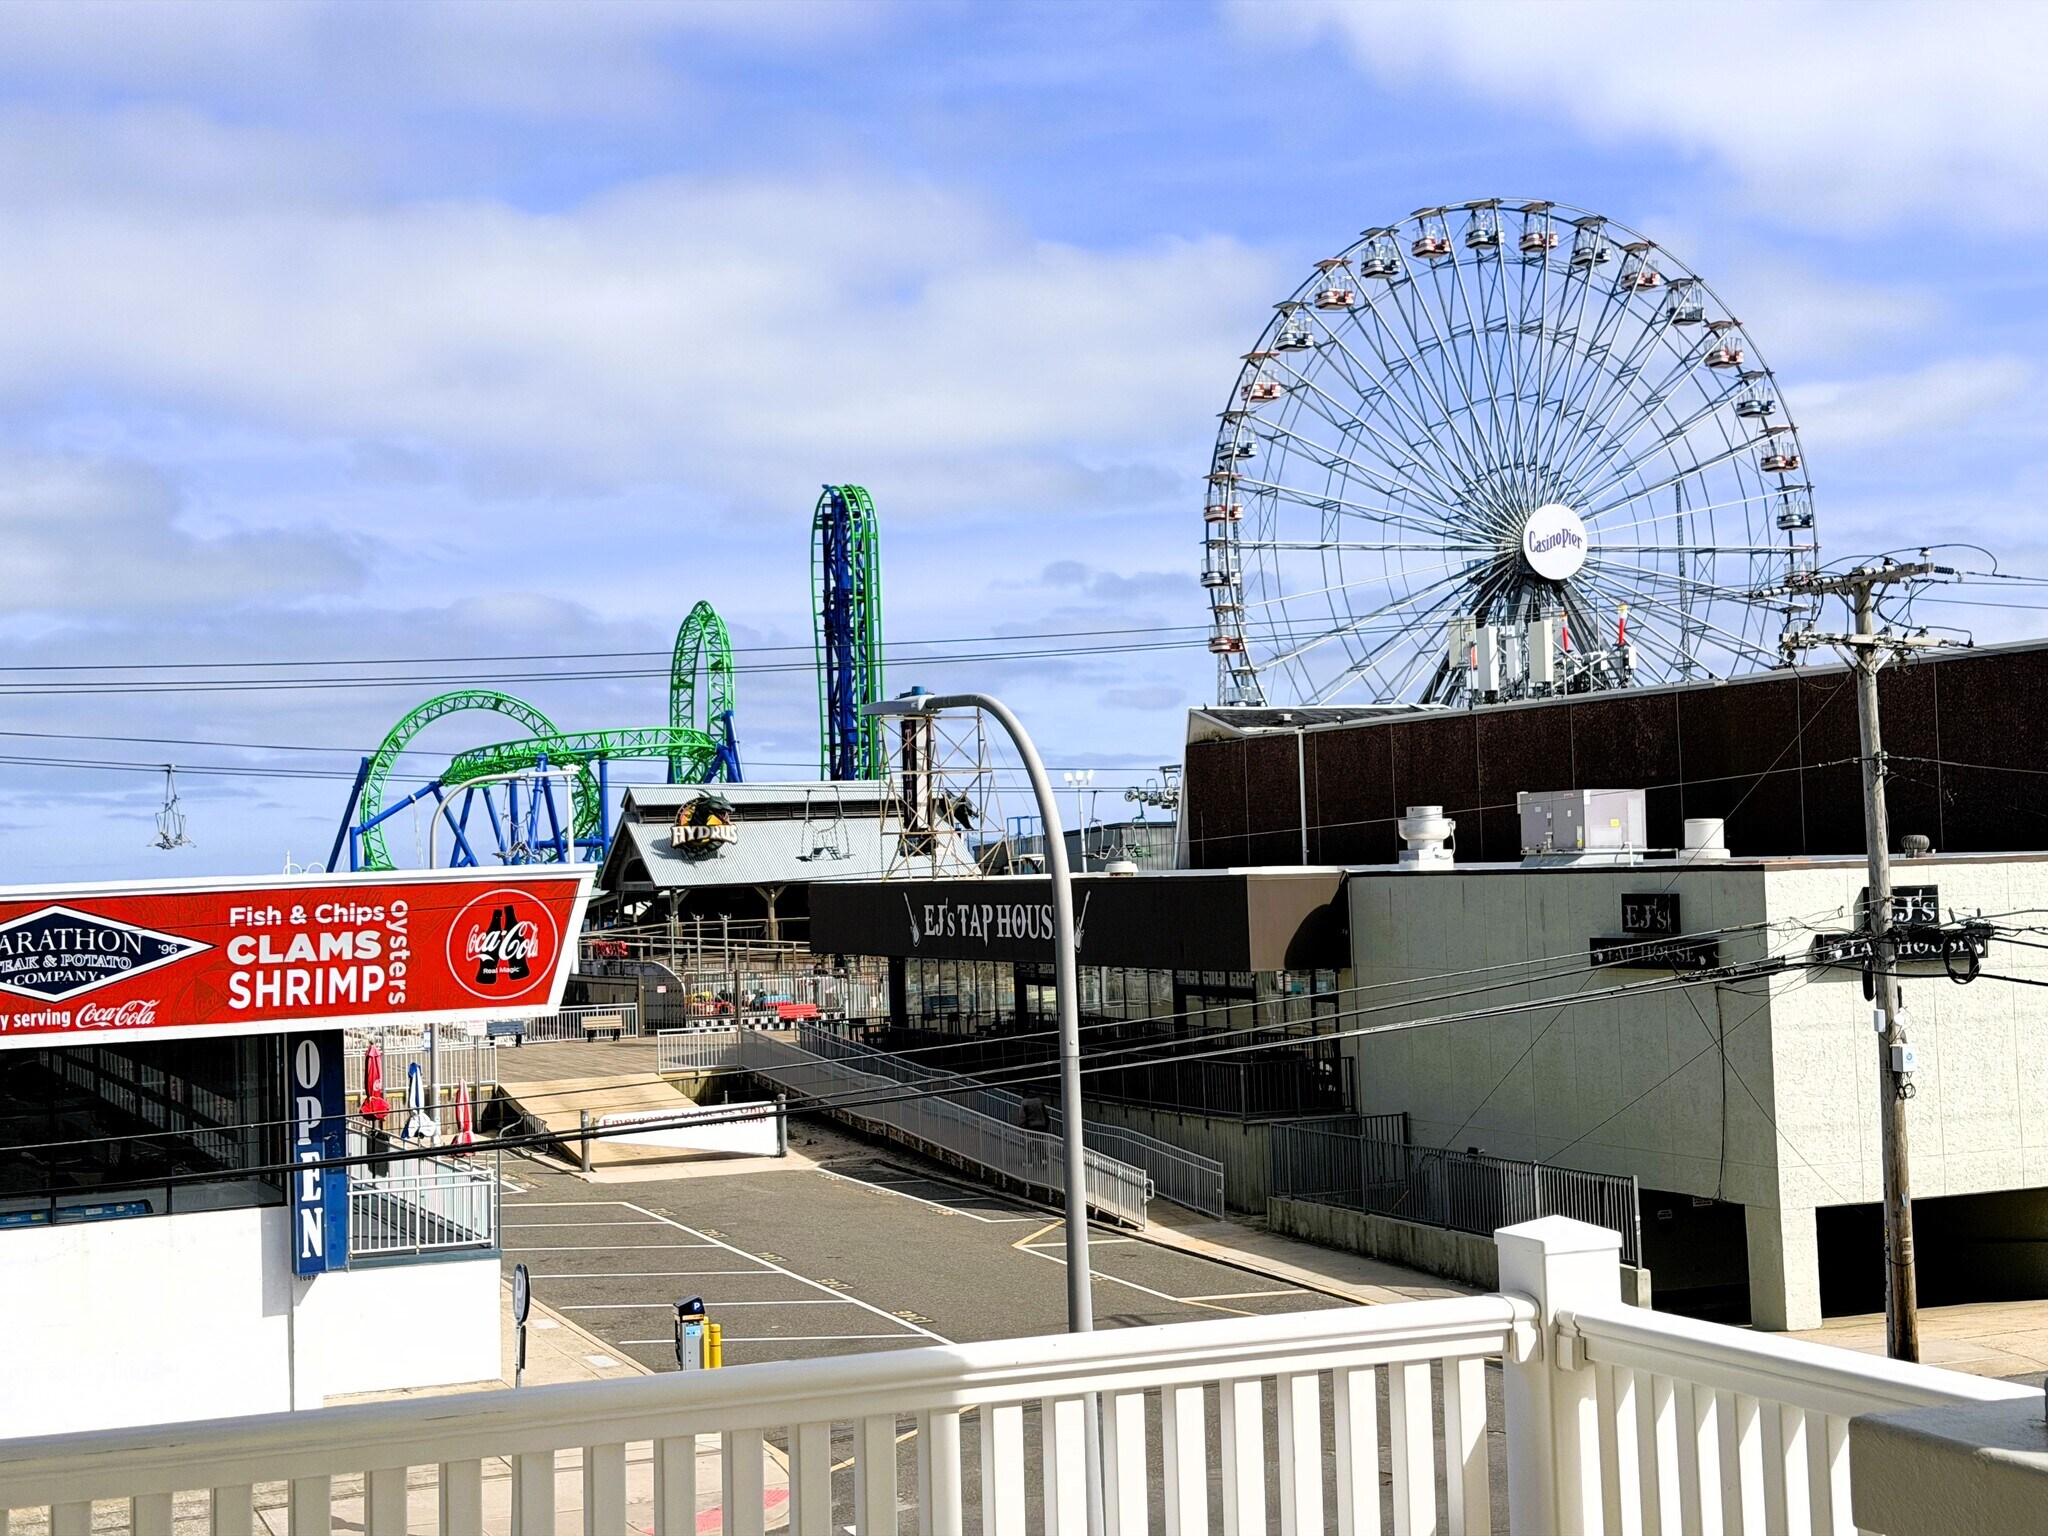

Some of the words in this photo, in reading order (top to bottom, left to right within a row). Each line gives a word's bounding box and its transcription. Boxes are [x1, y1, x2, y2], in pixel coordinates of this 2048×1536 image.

[671, 825, 738, 848] HYDRUS
[230, 905, 282, 927] Fish
[289, 905, 307, 925] &
[315, 902, 385, 926] Chips
[957, 904, 993, 947] TAP
[996, 904, 1056, 940] HOUS
[227, 930, 382, 965] CLAMS
[466, 921, 538, 961] Coca-Cola
[0, 956, 39, 973] EAK
[60, 954, 132, 970] POTATO
[499, 966, 520, 974] Magic
[13, 971, 98, 985] COMPANY
[228, 965, 385, 1009] SHRIMP
[14, 1009, 71, 1028] serving
[76, 1000, 160, 1028] Coca-Cola
[602, 1115, 675, 1128] Emerge
[295, 1039, 324, 1259] OPEN
